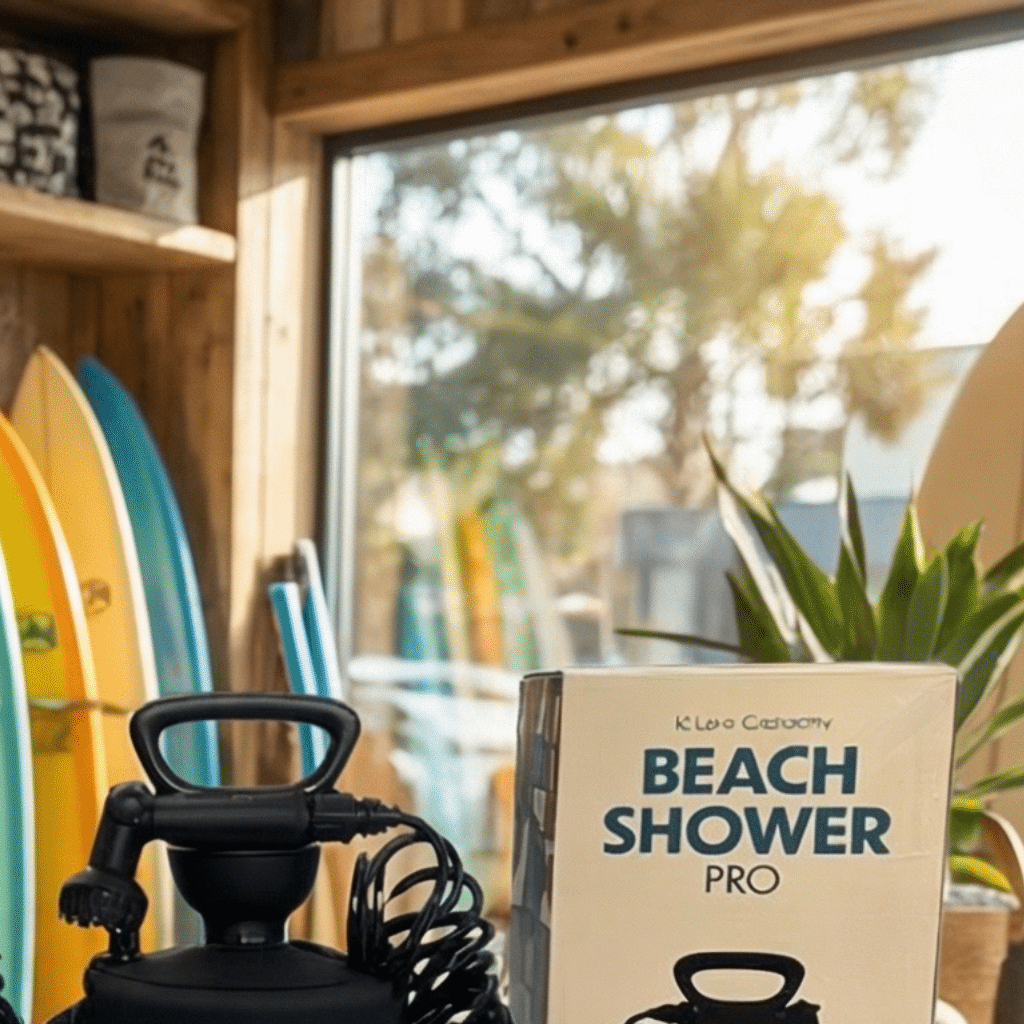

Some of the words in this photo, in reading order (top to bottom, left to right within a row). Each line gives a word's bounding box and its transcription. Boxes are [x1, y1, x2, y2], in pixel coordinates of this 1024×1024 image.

[642, 745, 858, 795] BEACH
[603, 805, 892, 856] SHOWER
[705, 864, 780, 895] PRO
